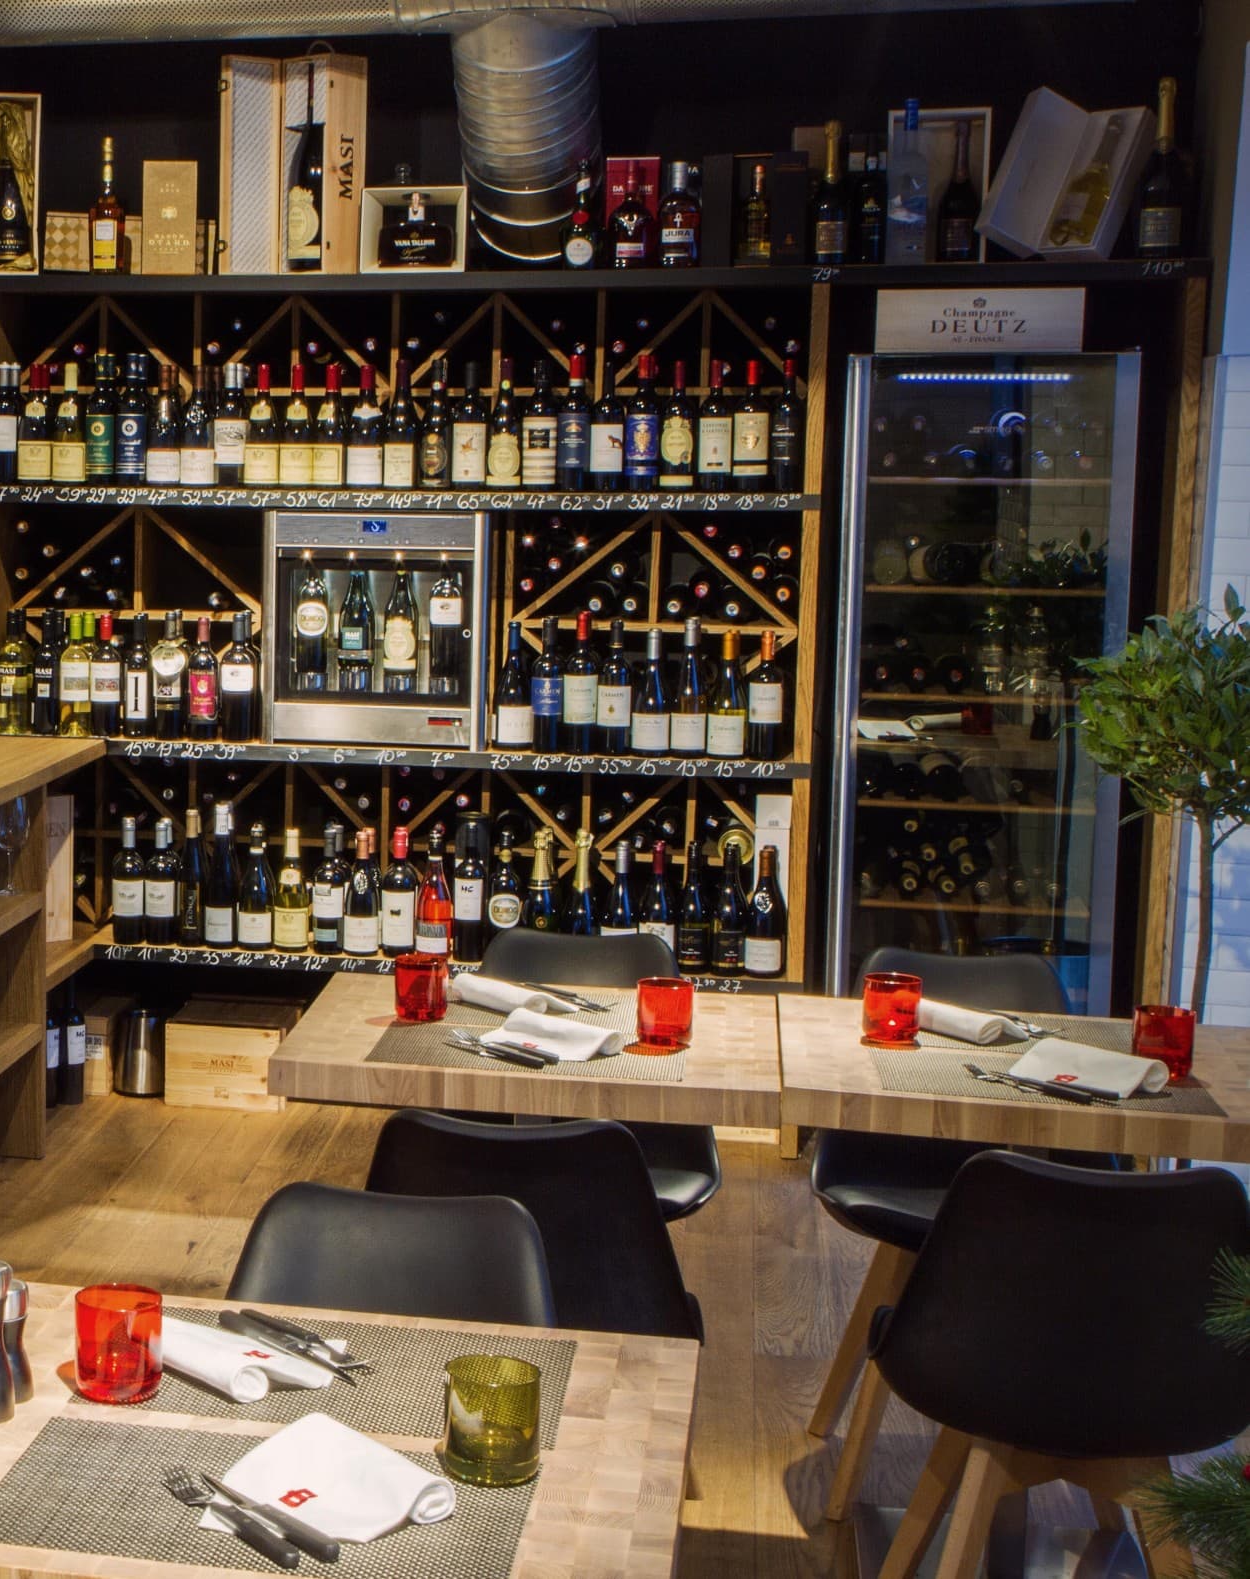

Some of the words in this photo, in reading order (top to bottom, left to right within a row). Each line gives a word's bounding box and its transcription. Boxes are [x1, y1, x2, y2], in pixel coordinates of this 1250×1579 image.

[337, 133, 355, 201] MASI
[664, 229, 690, 238] JURA
[942, 307, 1016, 319] Champagne
[930, 319, 1027, 334] DEUTZ
